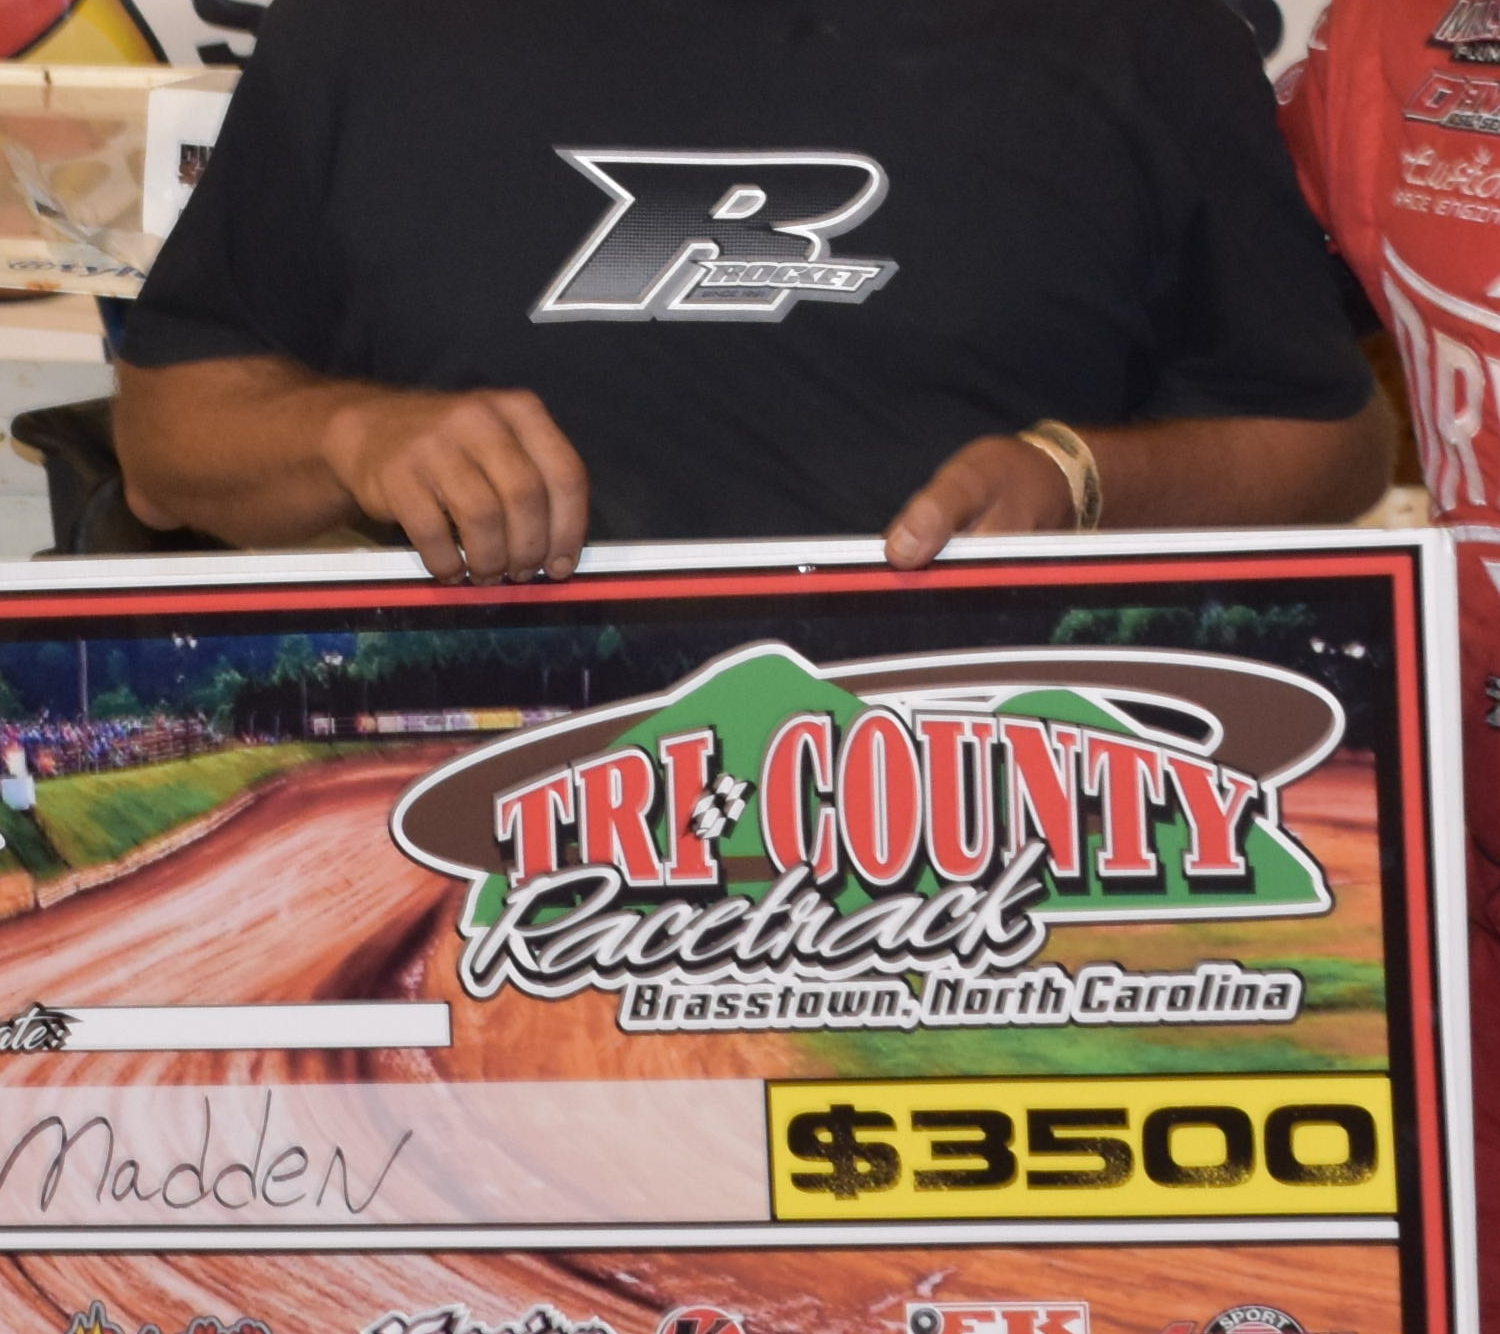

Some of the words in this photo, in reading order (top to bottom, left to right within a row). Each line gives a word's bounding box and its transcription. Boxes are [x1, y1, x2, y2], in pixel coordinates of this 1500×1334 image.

[700, 261, 882, 292] ROCKET
[490, 729, 718, 891] TRI
[757, 707, 1265, 885] COUNTY
[469, 839, 1049, 977] Racetrack
[629, 977, 917, 1028] Brasstown,
[925, 975, 1069, 1018] North
[1077, 971, 1297, 1016] Carolina
[783, 1099, 1381, 1202] $3500
[1218, 1307, 1292, 1332] SPORT
